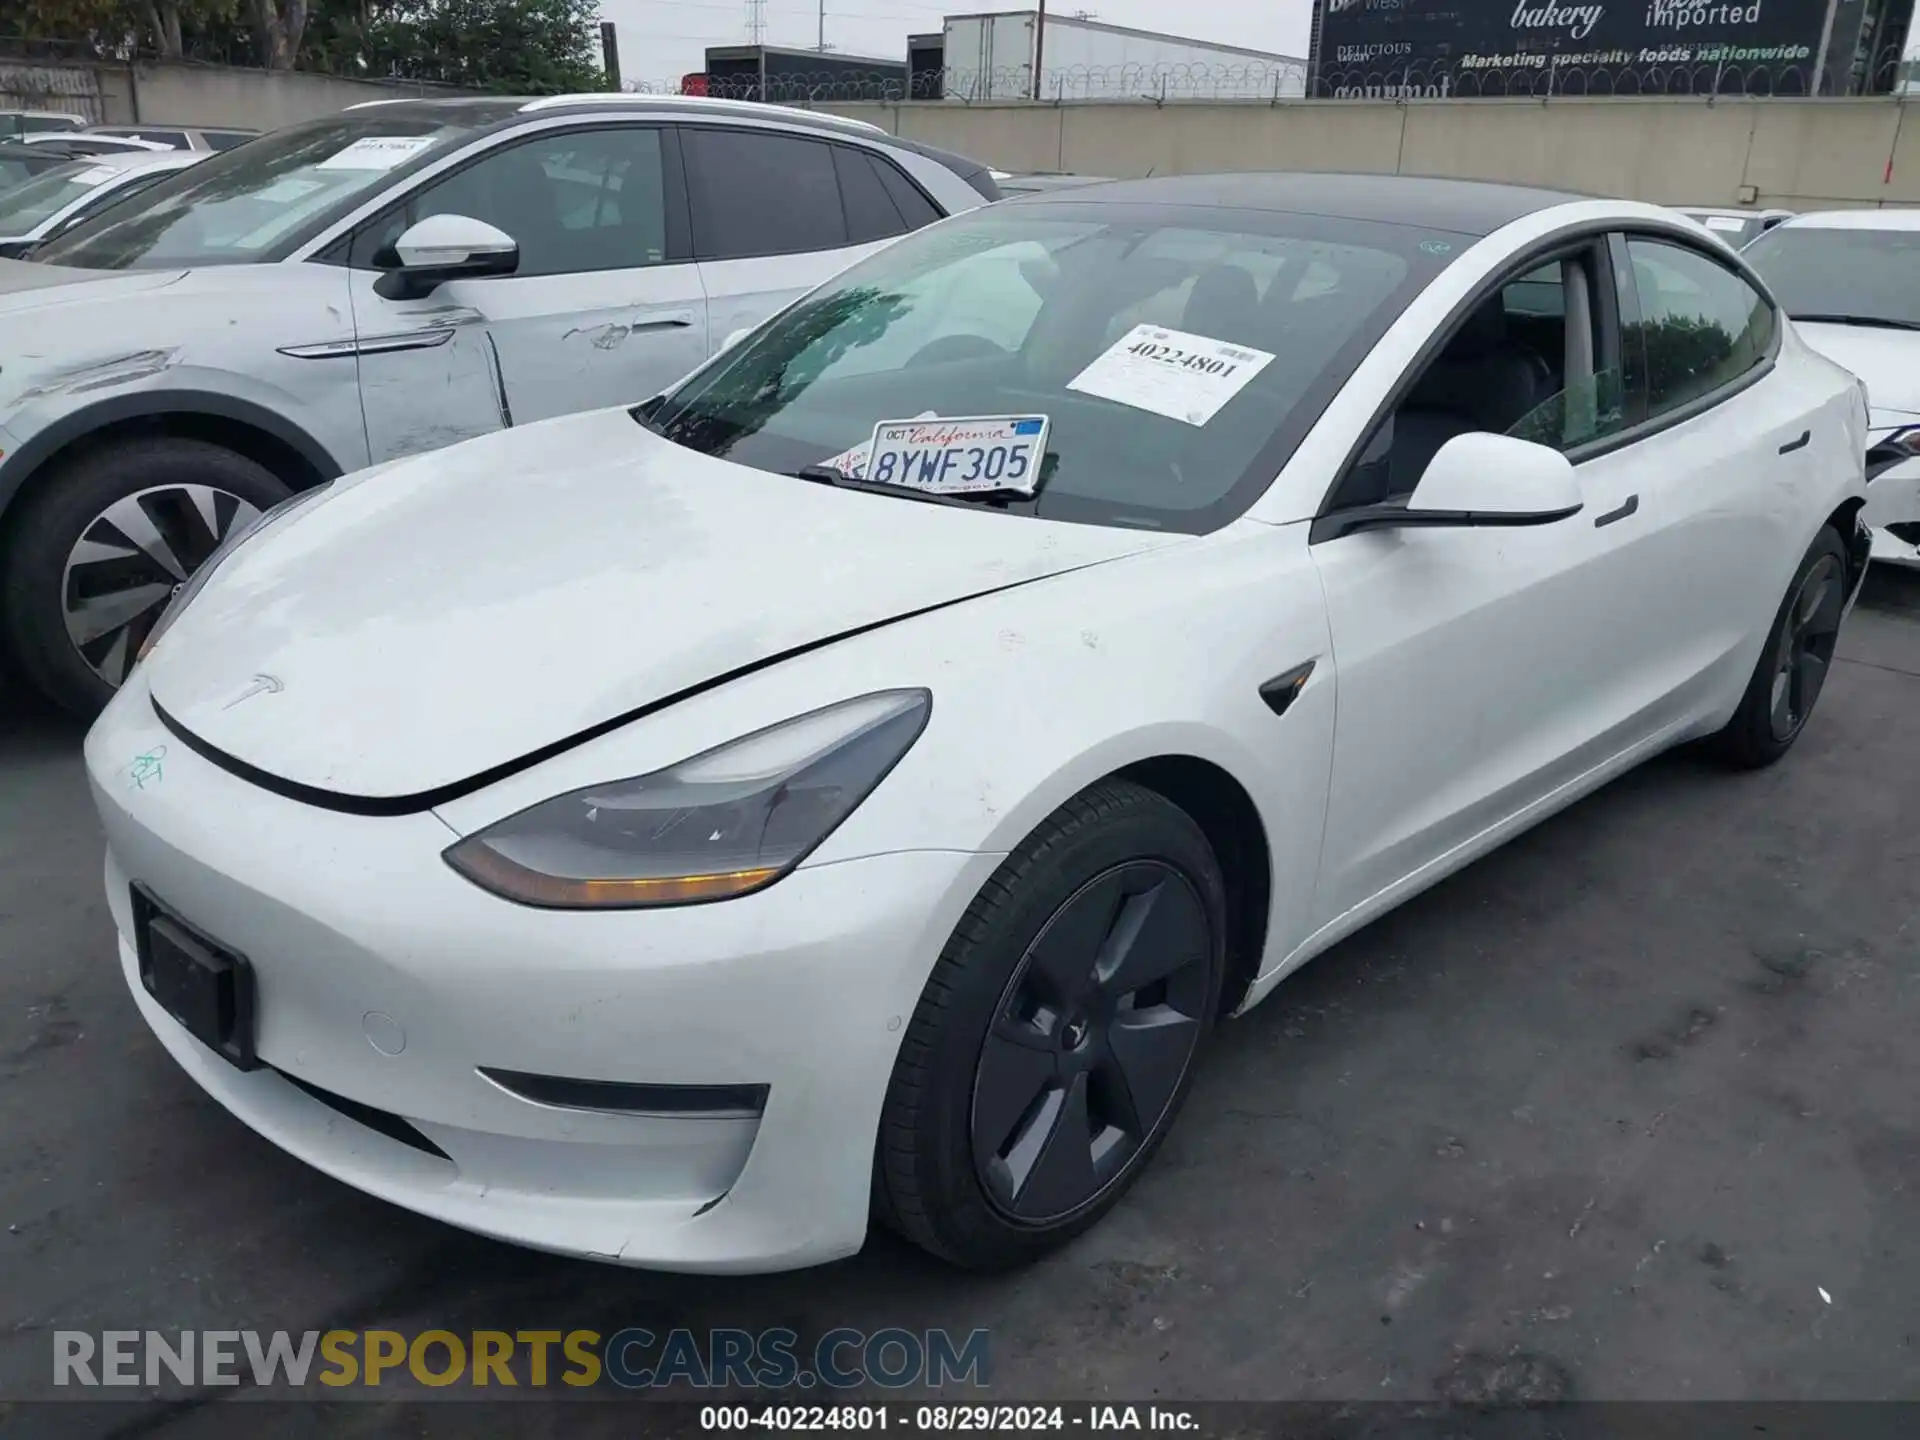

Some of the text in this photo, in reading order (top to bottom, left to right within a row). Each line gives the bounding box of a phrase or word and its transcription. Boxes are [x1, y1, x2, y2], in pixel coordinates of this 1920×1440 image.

[1510, 0, 1606, 39] bakery
[1645, 0, 1762, 30] imported
[1337, 42, 1412, 57] DELICIOUS
[1461, 52, 1546, 68] Marketing
[1552, 49, 1634, 66] specialty
[1639, 47, 1691, 62] foods
[1696, 44, 1810, 61] nationwide
[1127, 341, 1238, 378] 40224801
[886, 423, 1014, 447] OCT California
[874, 444, 1030, 483] 8YWF305
